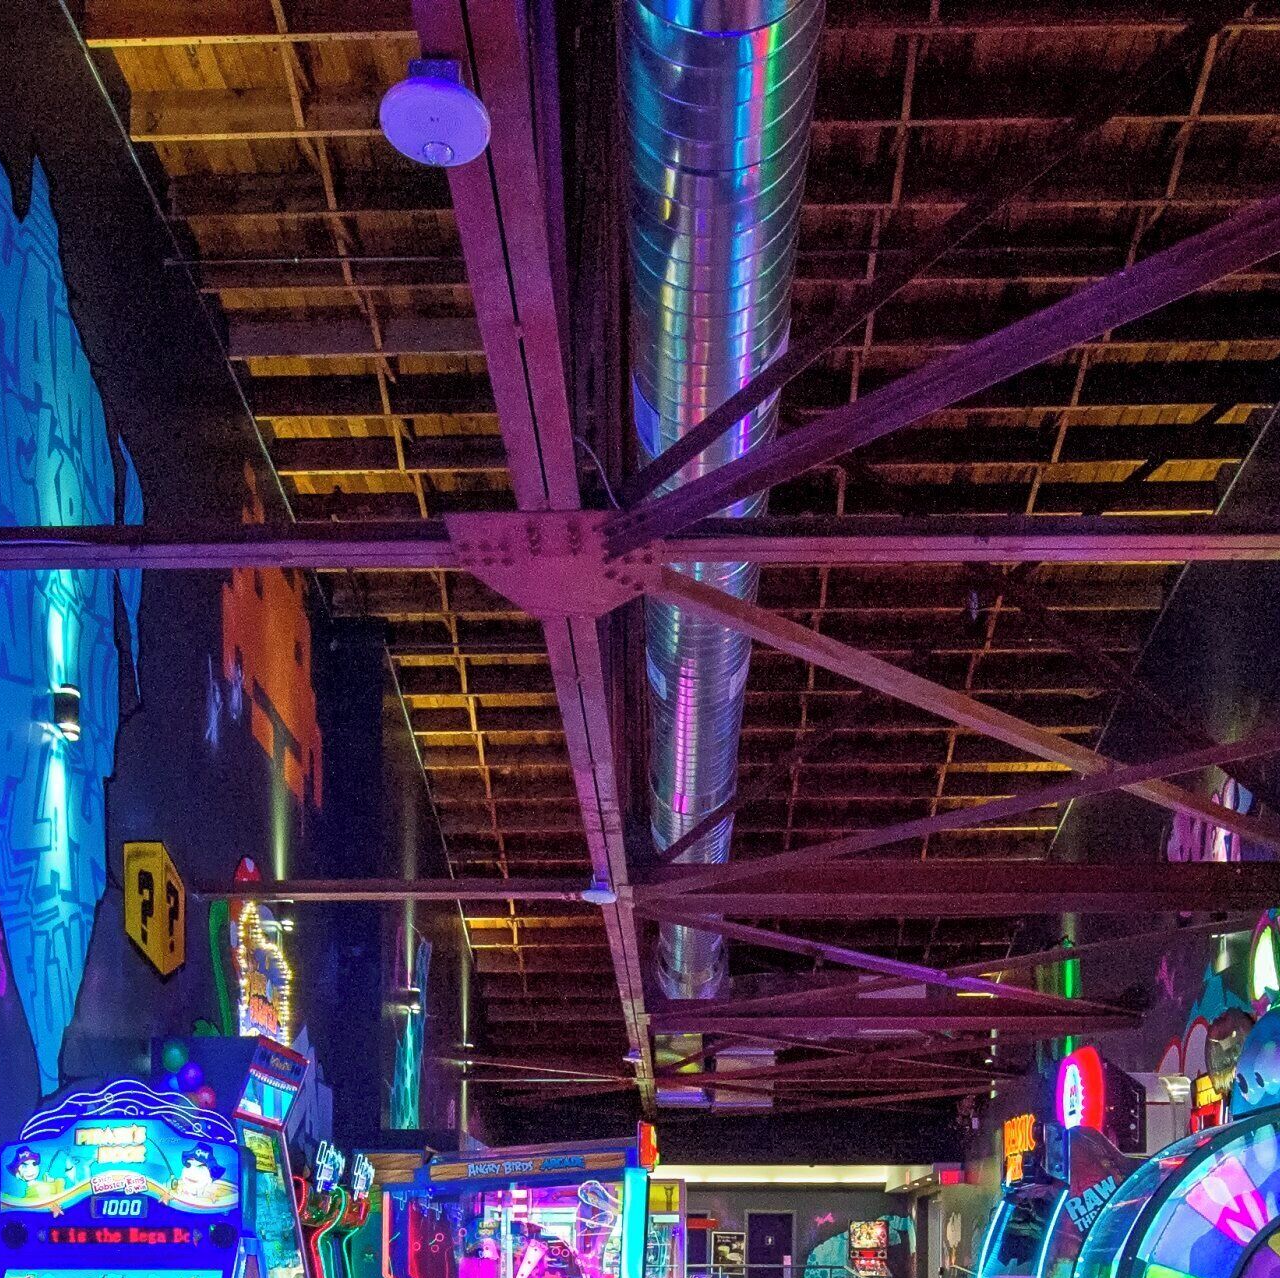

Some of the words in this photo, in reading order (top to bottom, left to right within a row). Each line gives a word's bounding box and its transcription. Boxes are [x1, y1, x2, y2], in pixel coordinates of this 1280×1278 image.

[468, 1162, 500, 1177] ANGRY
[1065, 1176, 1117, 1221] RAW
[102, 1199, 142, 1217] 1000
[68, 1227, 87, 1243] is
[95, 1227, 122, 1243] the
